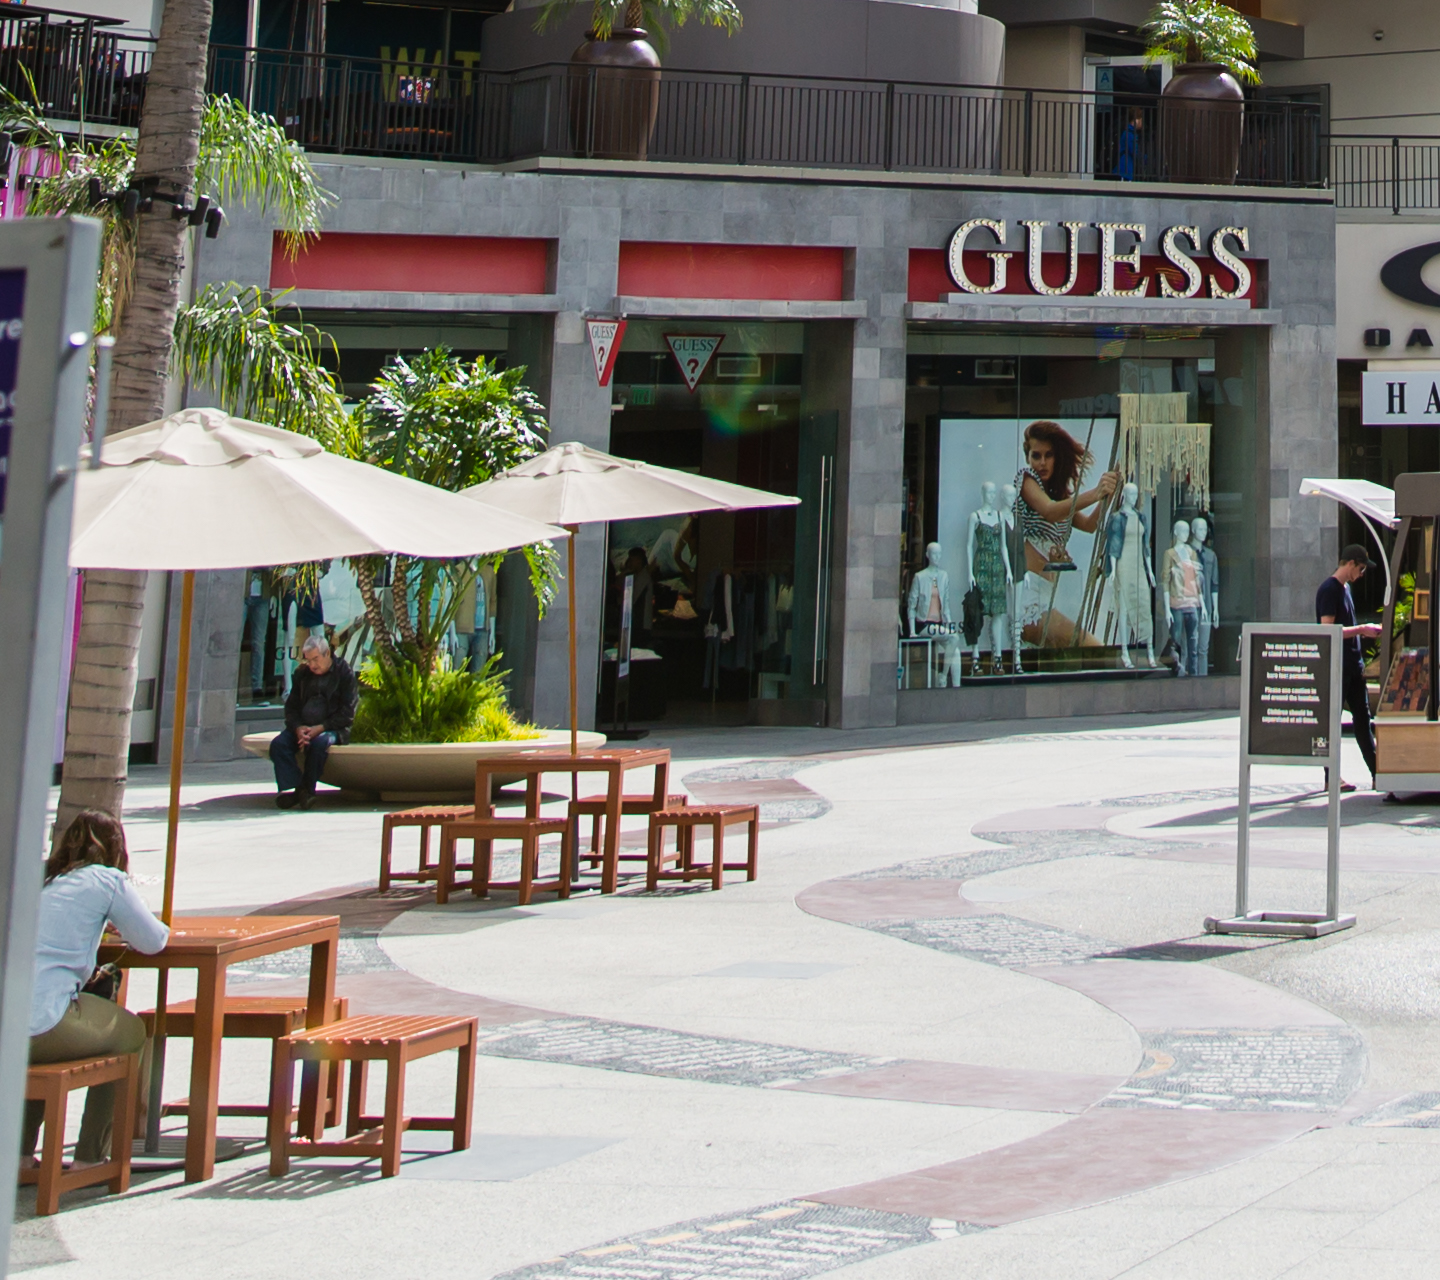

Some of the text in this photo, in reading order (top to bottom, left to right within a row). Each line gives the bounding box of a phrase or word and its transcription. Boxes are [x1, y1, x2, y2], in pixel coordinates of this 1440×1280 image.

[1100, 71, 1110, 83] A
[946, 217, 1252, 299] GUESS
[591, 324, 614, 339] GUESS
[672, 337, 714, 353] GUESS
[927, 621, 965, 636] GUES
